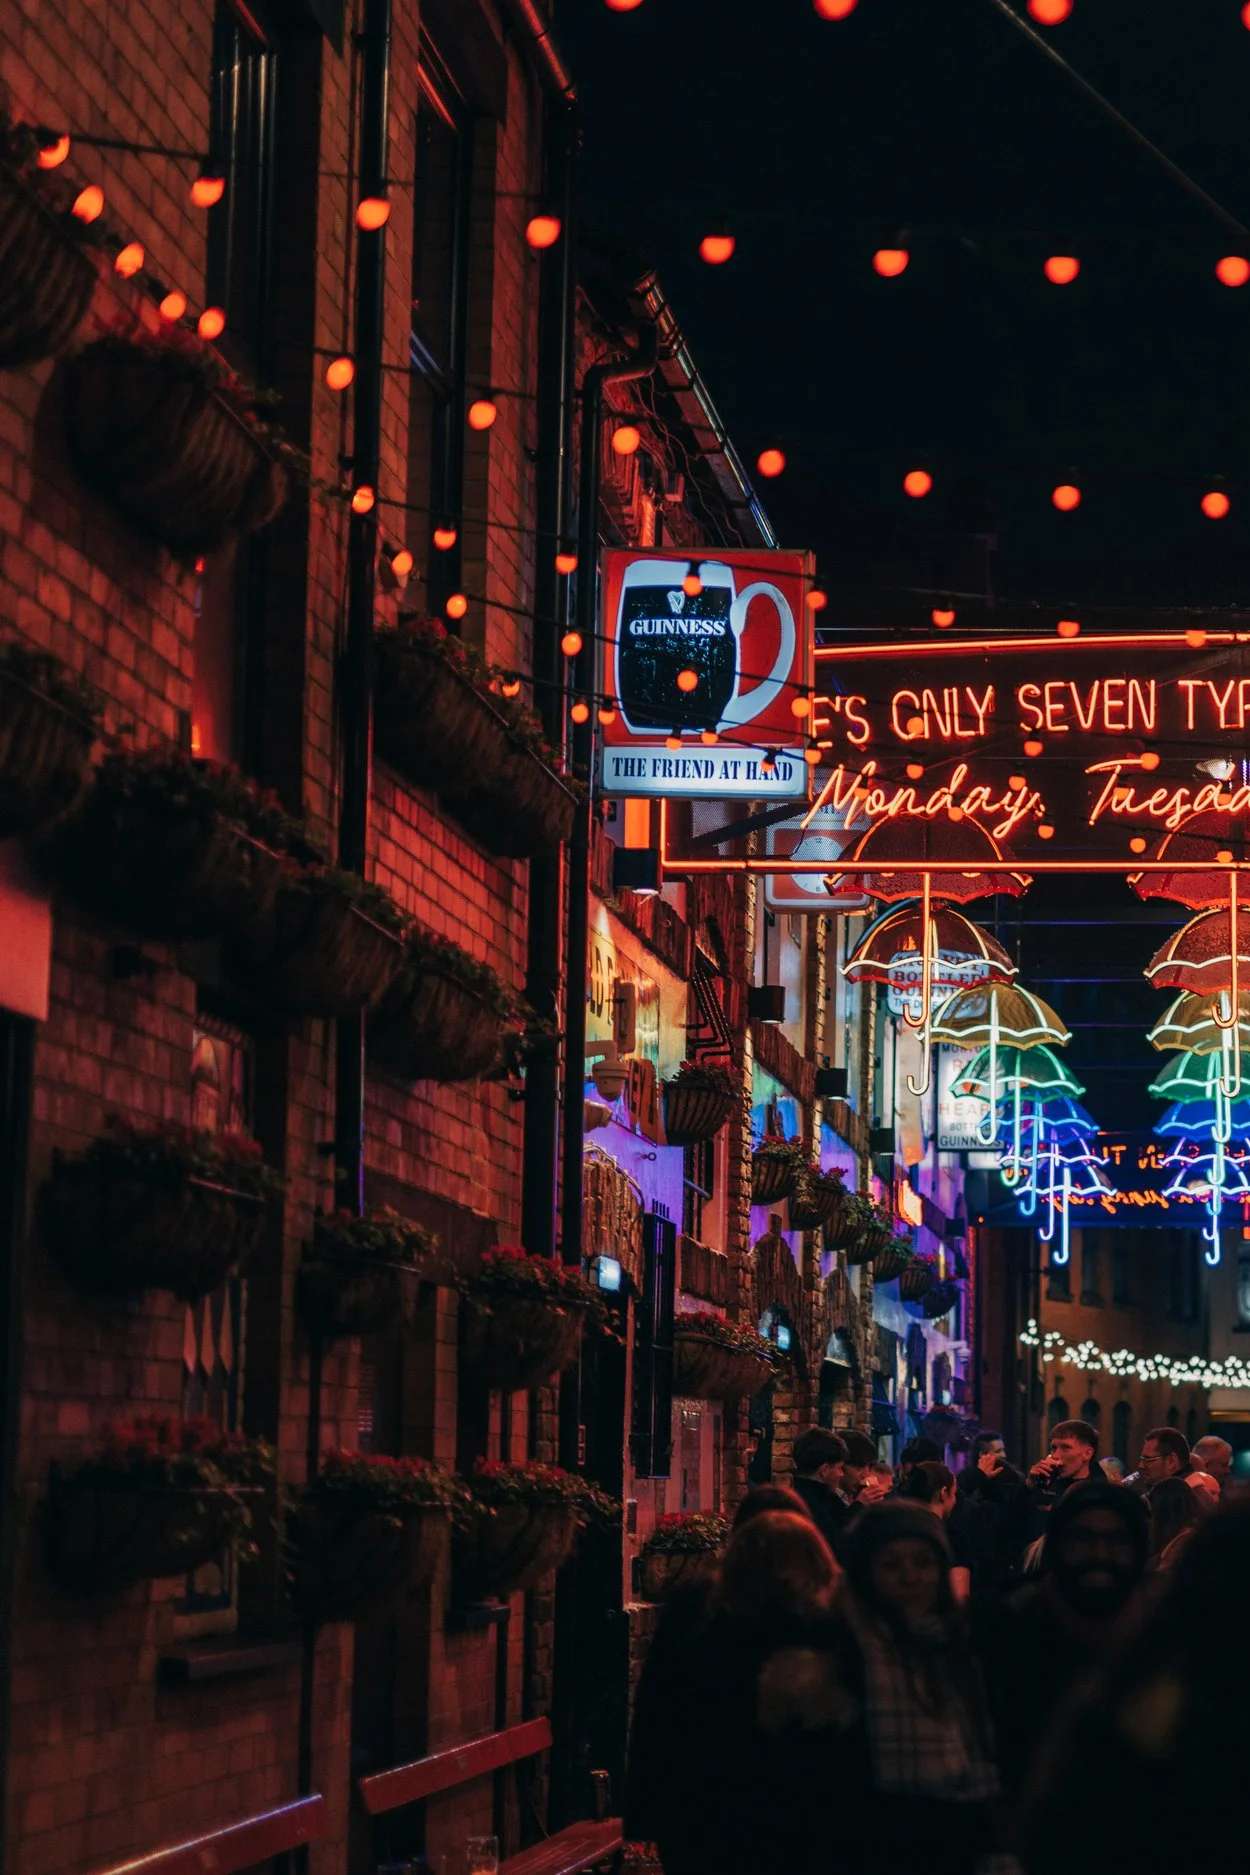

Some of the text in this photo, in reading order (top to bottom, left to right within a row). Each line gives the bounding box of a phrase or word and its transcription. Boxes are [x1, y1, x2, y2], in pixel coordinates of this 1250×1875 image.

[629, 618, 726, 637] GUINNESS
[1017, 678, 1155, 732] SEVEN
[612, 757, 794, 782] THE FRIEND AT HAND
